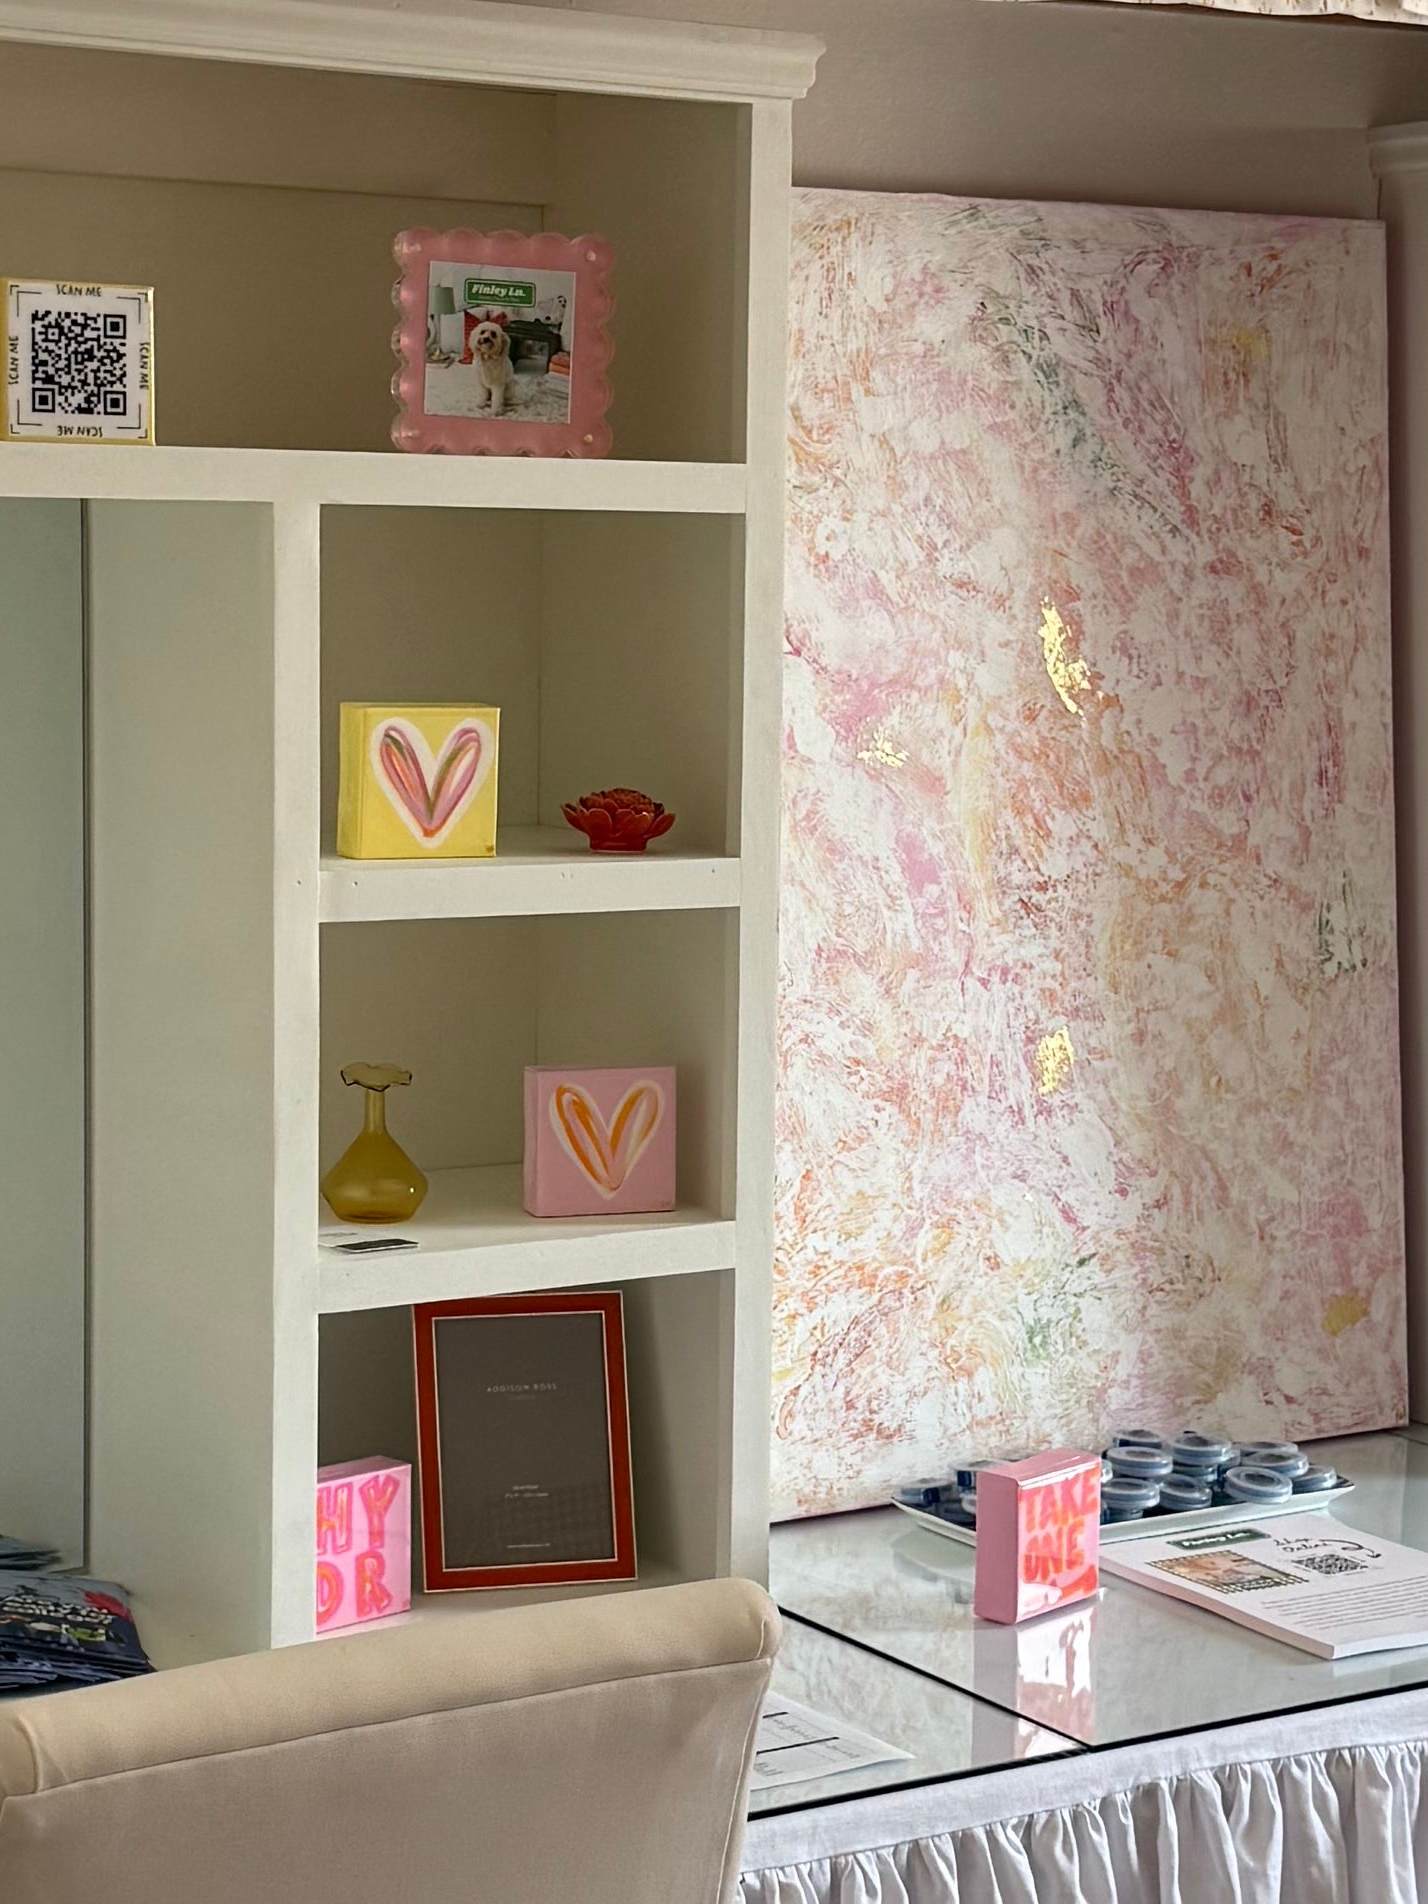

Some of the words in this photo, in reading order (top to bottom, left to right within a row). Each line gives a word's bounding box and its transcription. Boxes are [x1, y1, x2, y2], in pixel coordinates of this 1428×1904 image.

[56, 284, 82, 296] SCAN
[85, 286, 102, 297] ME
[8, 336, 19, 354] ME
[8, 359, 19, 385] SCAN
[1018, 1462, 1102, 1533] TAKE
[1024, 1517, 1085, 1584] ONE
